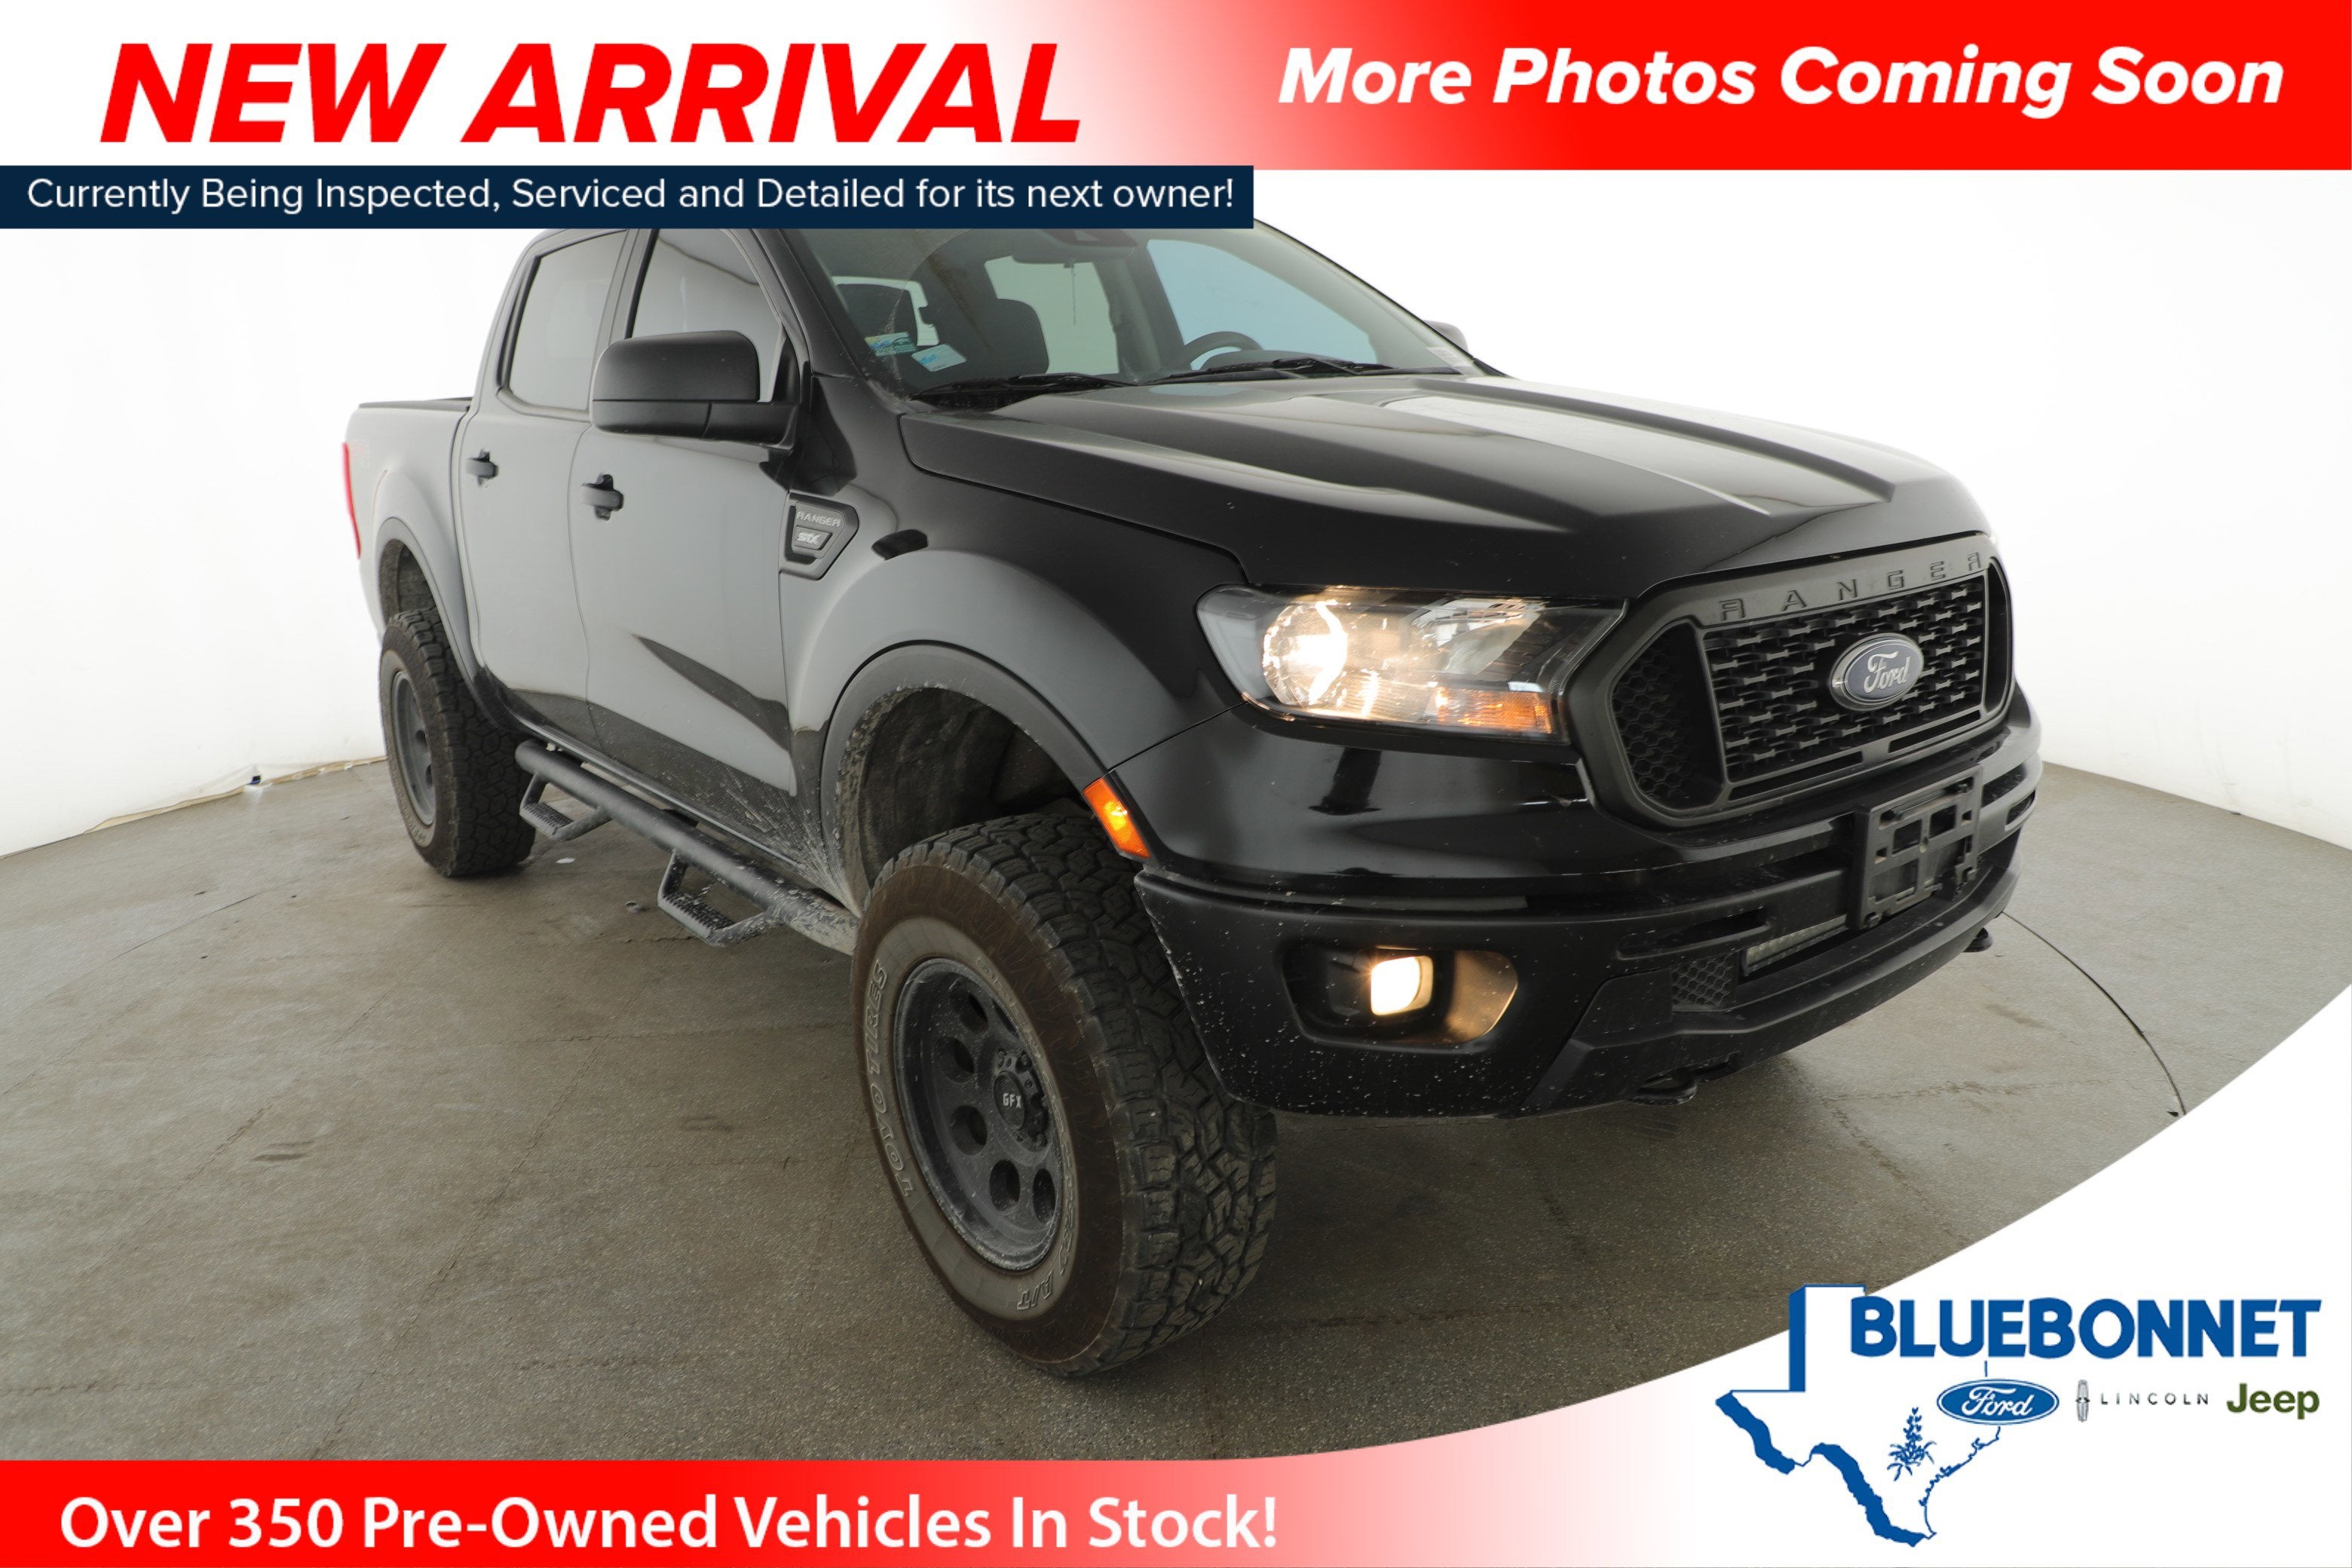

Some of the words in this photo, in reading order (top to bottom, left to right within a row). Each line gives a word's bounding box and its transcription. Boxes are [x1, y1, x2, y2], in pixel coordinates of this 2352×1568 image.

[795, 510, 843, 528] RANGER
[1718, 551, 1981, 621] RANGER
[1863, 649, 1911, 694] Ford
[864, 957, 888, 1076] TIRES
[1003, 1092, 1022, 1109] GFX
[870, 1083, 914, 1197] TOYO
